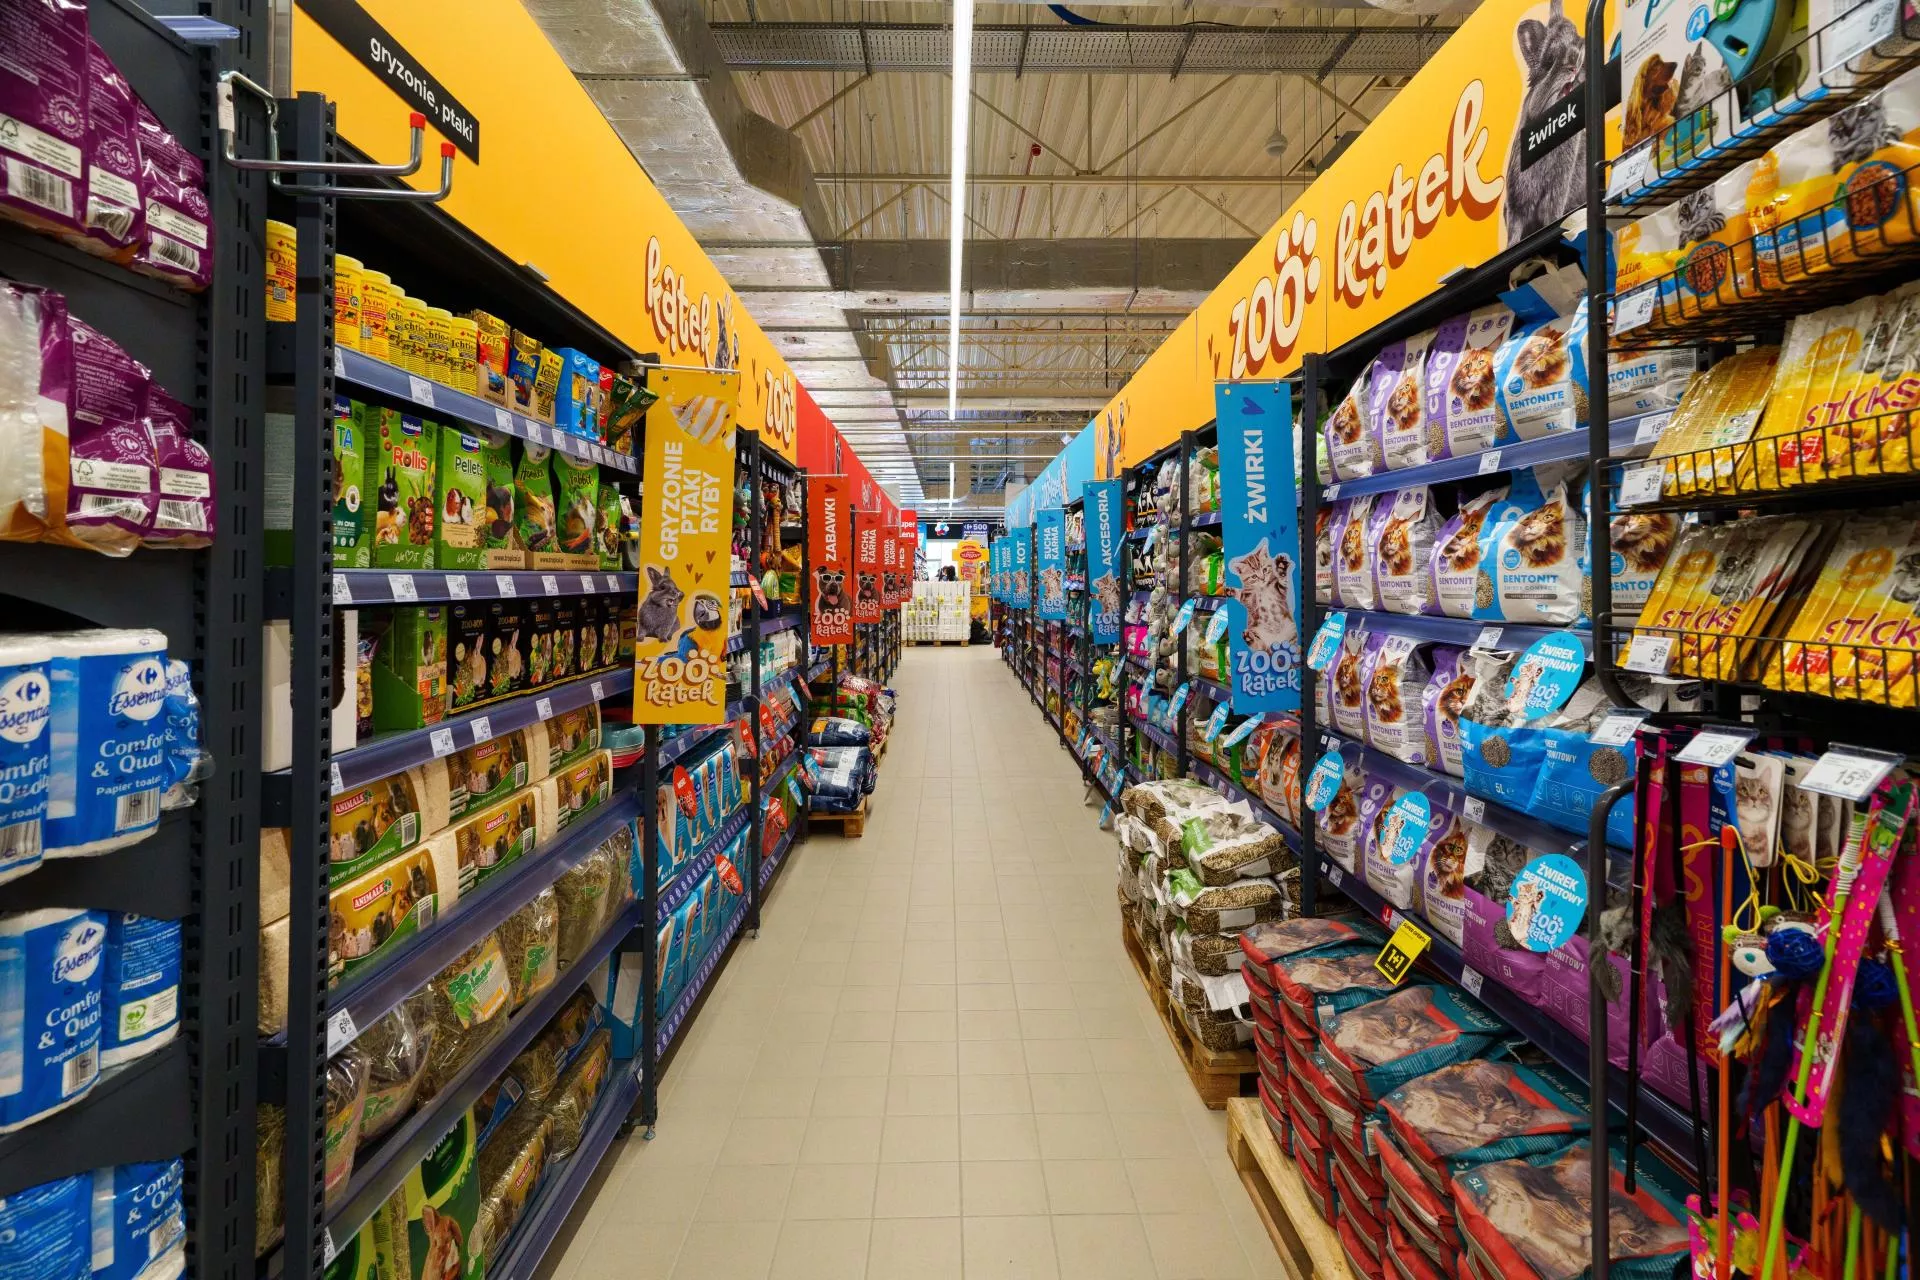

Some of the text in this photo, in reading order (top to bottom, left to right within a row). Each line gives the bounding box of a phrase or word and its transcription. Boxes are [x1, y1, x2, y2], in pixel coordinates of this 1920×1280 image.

[370, 38, 473, 143] gryzonie, ptaki
[1527, 102, 1577, 151] żwirek
[1334, 79, 1504, 308] kątek
[645, 235, 715, 370] kątek
[1510, 390, 1564, 410] BENTONITE
[1803, 377, 1920, 430] STICKS
[1450, 414, 1496, 429] BENTONITE
[393, 446, 428, 471] Rollis
[455, 455, 483, 476] Pellets
[1243, 429, 1267, 524] ŻWIRKI
[660, 441, 683, 560] GRYZONIE
[681, 469, 701, 535] PTAKI
[701, 471, 720, 533] RYBY
[825, 497, 836, 562] ZABAWKI
[1098, 489, 1112, 566] AKCESORIA
[868, 529, 876, 563] KARMA
[1017, 541, 1026, 563] KOT
[1439, 577, 1474, 585] BENTONIT
[1503, 574, 1558, 583] BENTONIT
[1525, 653, 1580, 673] DREWNIANY
[1538, 642, 1576, 660] ŻWIREK
[646, 679, 718, 707] kątek
[476, 744, 496, 757] ANIMALS
[91, 761, 110, 778] &
[96, 780, 132, 796] Papier
[335, 792, 364, 813] ANIMALS
[1402, 798, 1426, 818] ŻWIREK
[1522, 870, 1584, 907] BENTONITOWY
[1536, 861, 1580, 892] ŻWIREK
[354, 884, 385, 910] ANIMALS
[1425, 893, 1464, 917] BENTONITE
[1387, 948, 1405, 970] 1+1
[1503, 964, 1513, 979] 5L
[37, 1030, 56, 1050] &
[44, 1043, 78, 1068] Papier
[1468, 1178, 1480, 1190] 5L
